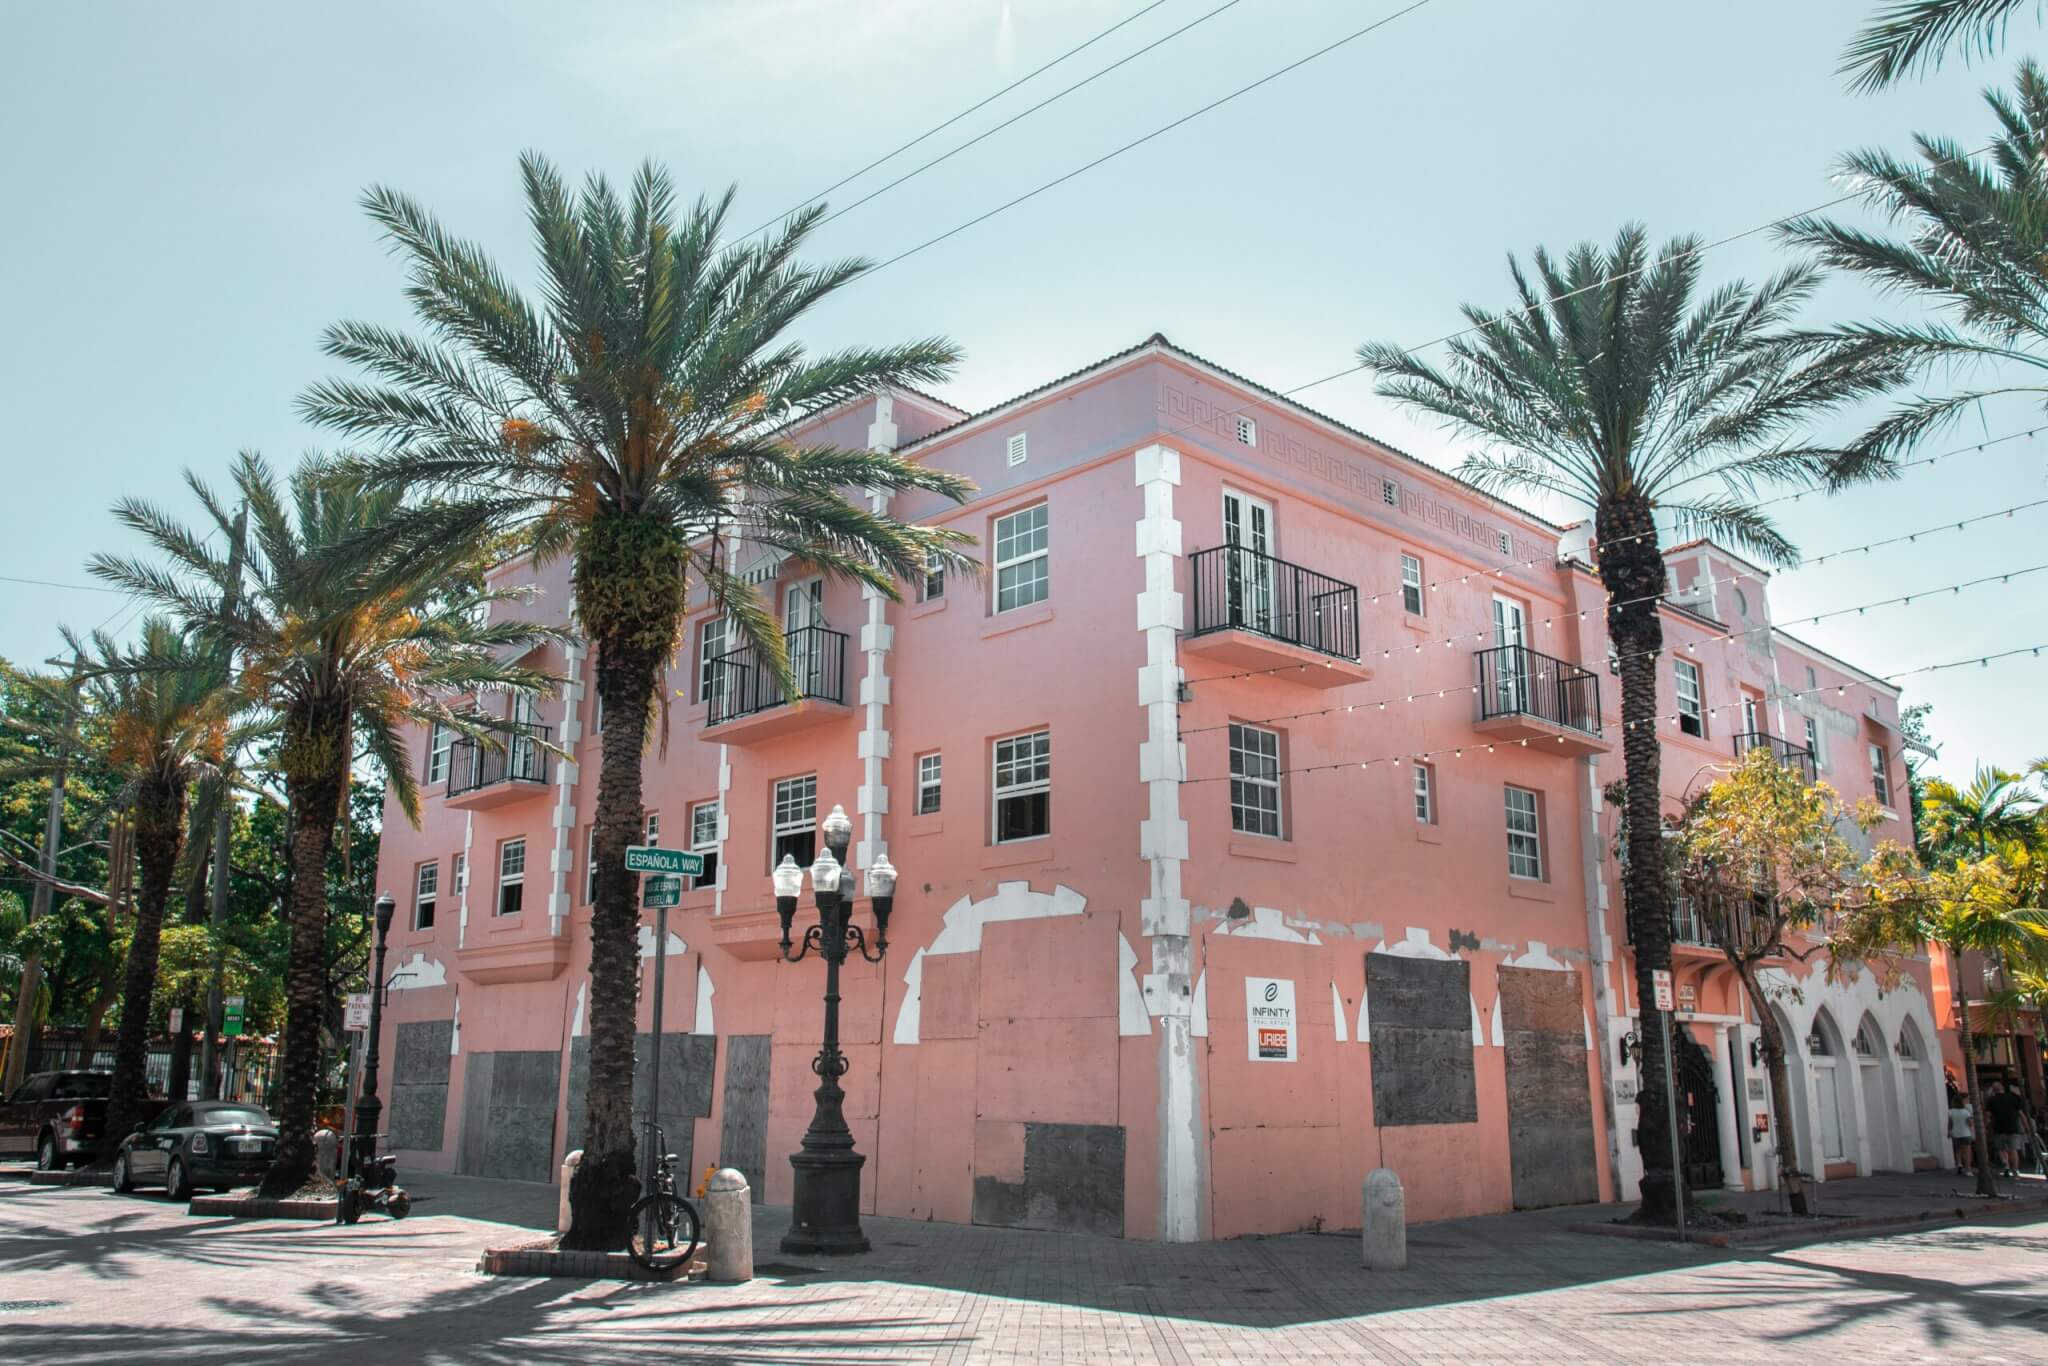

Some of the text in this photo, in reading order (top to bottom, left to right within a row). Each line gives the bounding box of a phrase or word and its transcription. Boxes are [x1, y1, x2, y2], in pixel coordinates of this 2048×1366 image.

[629, 853, 700, 872] ESPAÑOLA WAY
[1253, 1007, 1290, 1018] INFINITY
[1259, 1032, 1287, 1047] URIBE
